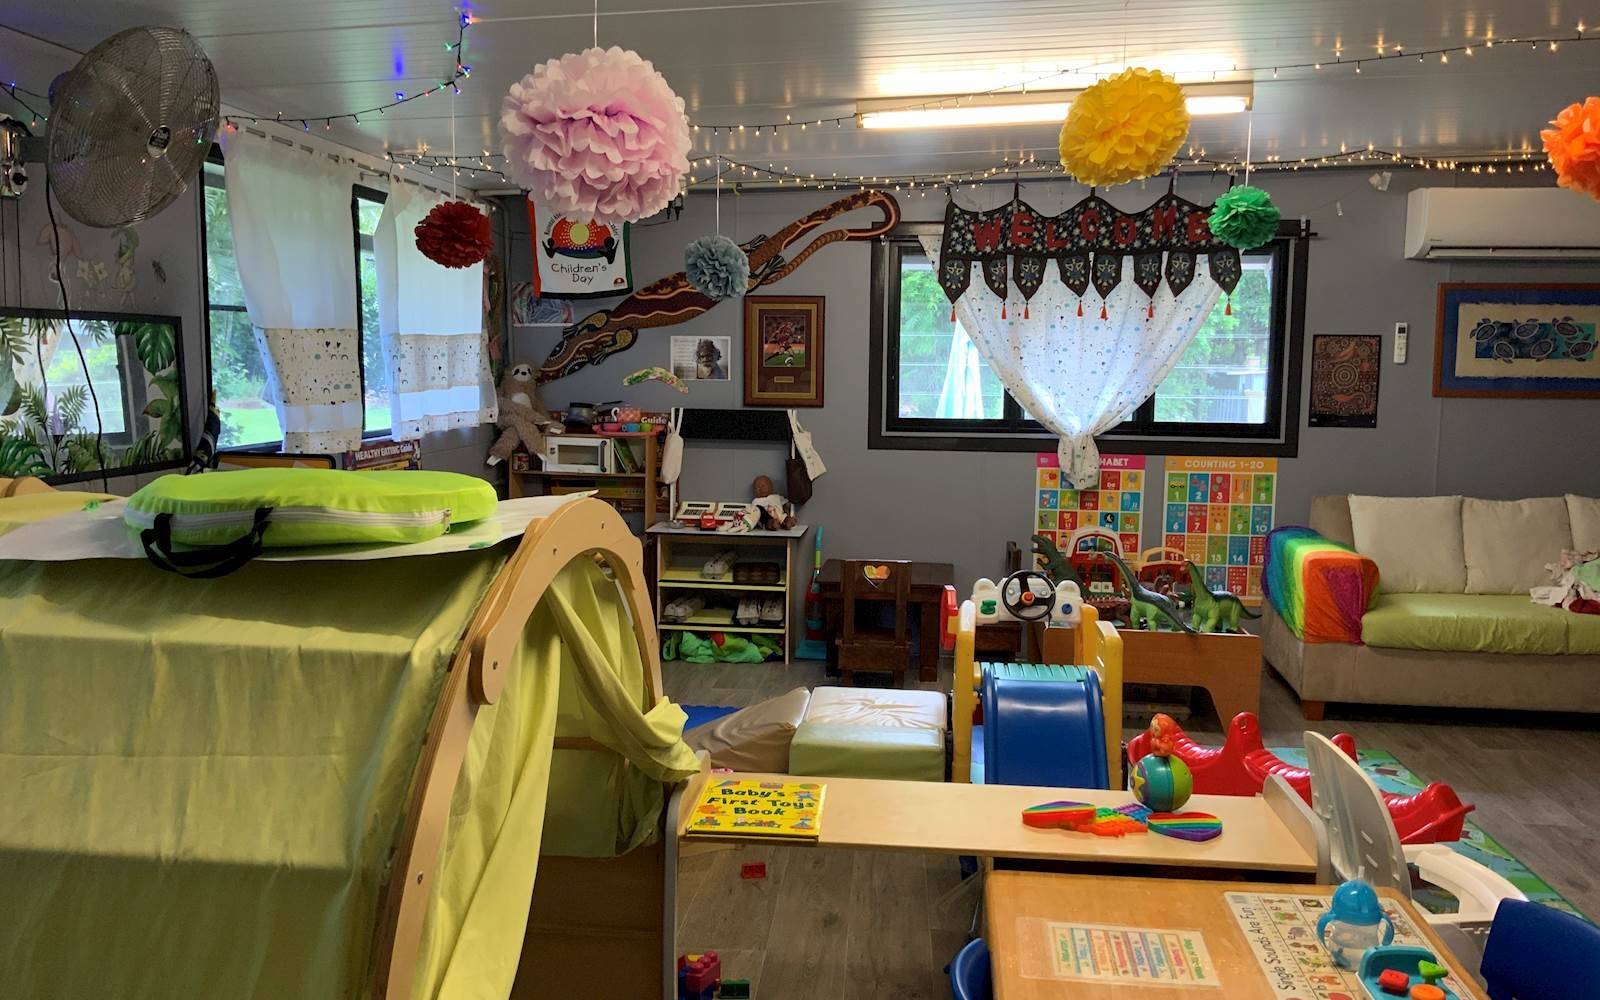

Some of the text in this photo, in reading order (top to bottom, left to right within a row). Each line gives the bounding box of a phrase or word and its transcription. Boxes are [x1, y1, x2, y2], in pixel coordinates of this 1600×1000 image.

[972, 206, 1211, 250] WELCOME
[551, 263, 607, 273] Children's
[572, 274, 594, 286] Day
[640, 416, 667, 424] Guide
[355, 448, 380, 461] HEALTHY
[380, 445, 400, 456] EATING
[1099, 458, 1129, 466] HABET
[1184, 460, 1265, 469] COUNTING 1-20
[1217, 492, 1223, 500] 3
[1237, 523, 1243, 531] 9
[1190, 553, 1201, 561] 12
[1211, 554, 1222, 562] 13
[1233, 554, 1243, 562] 14
[1231, 585, 1242, 593] 19
[721, 788, 785, 798] Baby's
[706, 797, 815, 809] First Toys
[734, 807, 786, 815] Book
[1248, 921, 1265, 935] Are
[1253, 936, 1281, 964] Sounds
